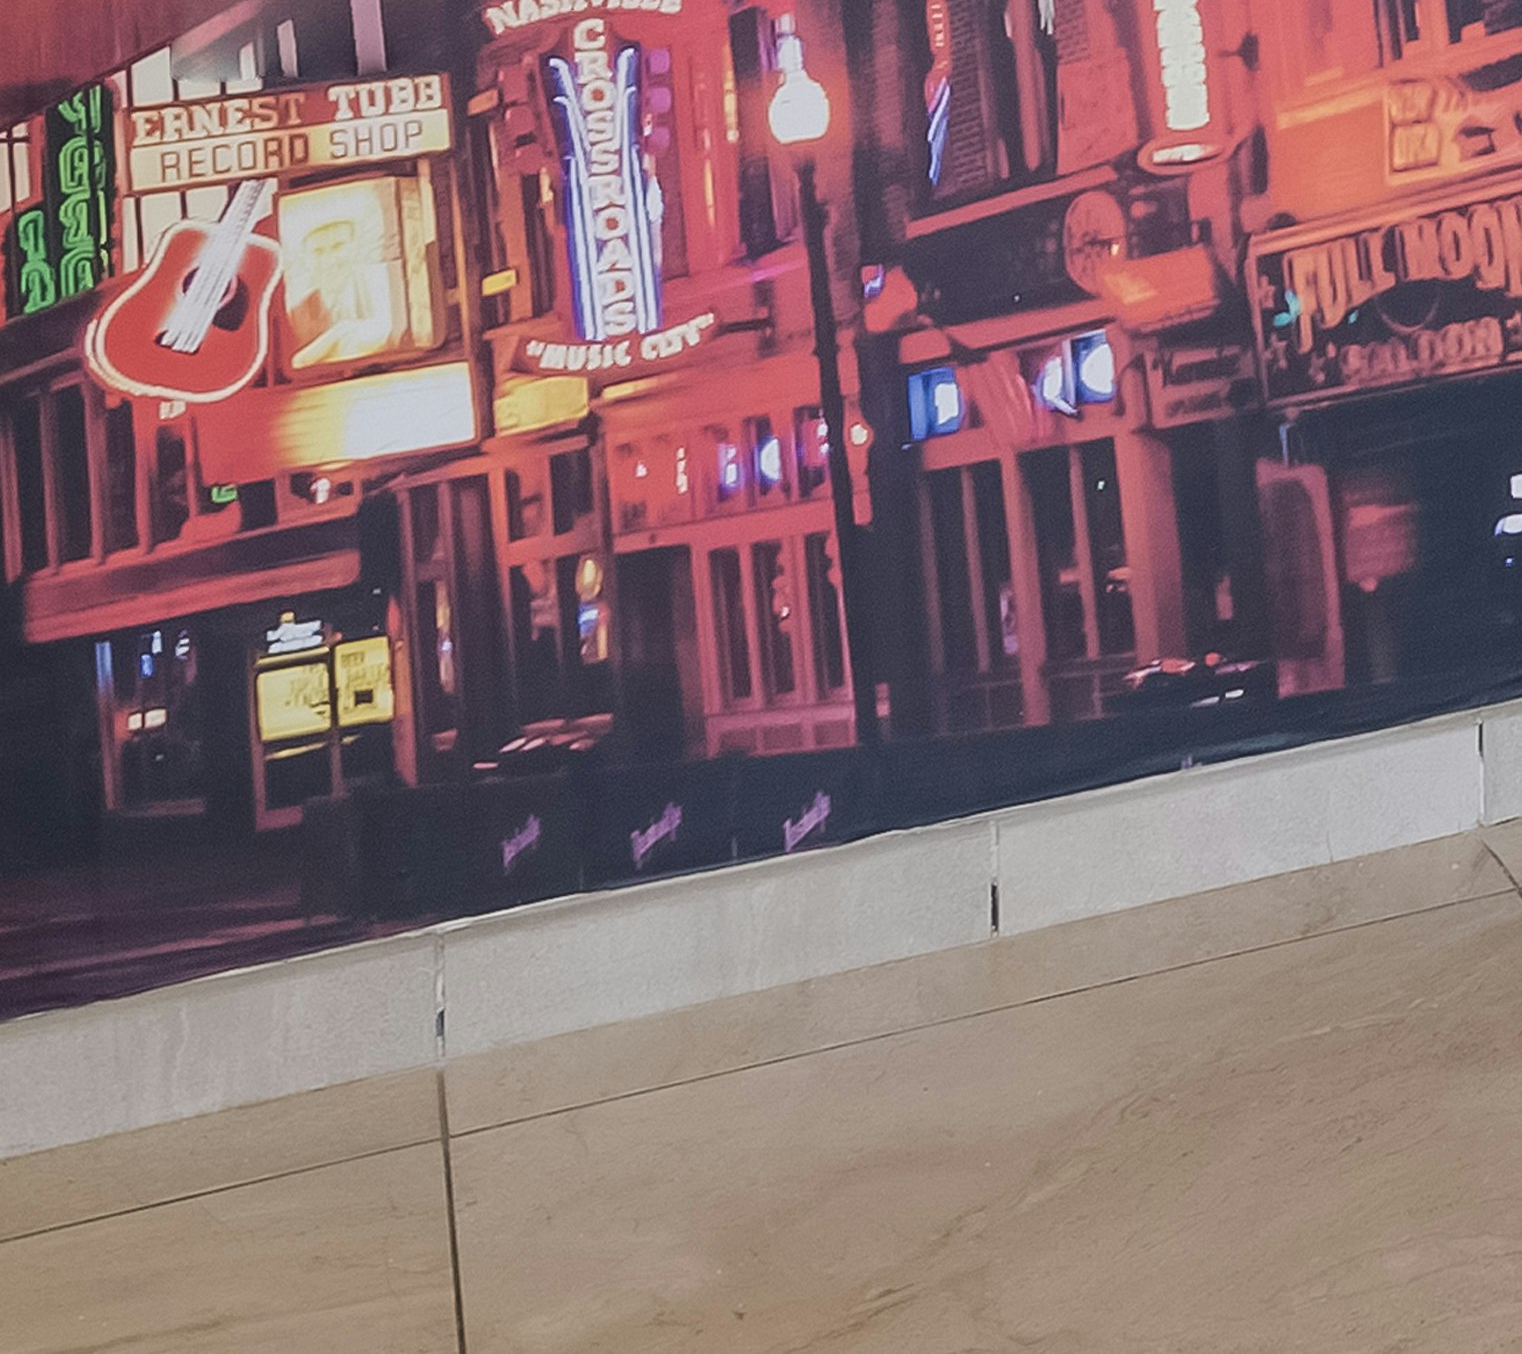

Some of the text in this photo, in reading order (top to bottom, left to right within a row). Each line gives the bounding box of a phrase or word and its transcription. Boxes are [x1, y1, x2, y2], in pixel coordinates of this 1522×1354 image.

[131, 75, 442, 144] ERNEST TUBB
[160, 120, 423, 182] RECORD SHOP
[573, 18, 637, 336] CROSSROADS
[1286, 224, 1396, 354] FULL
